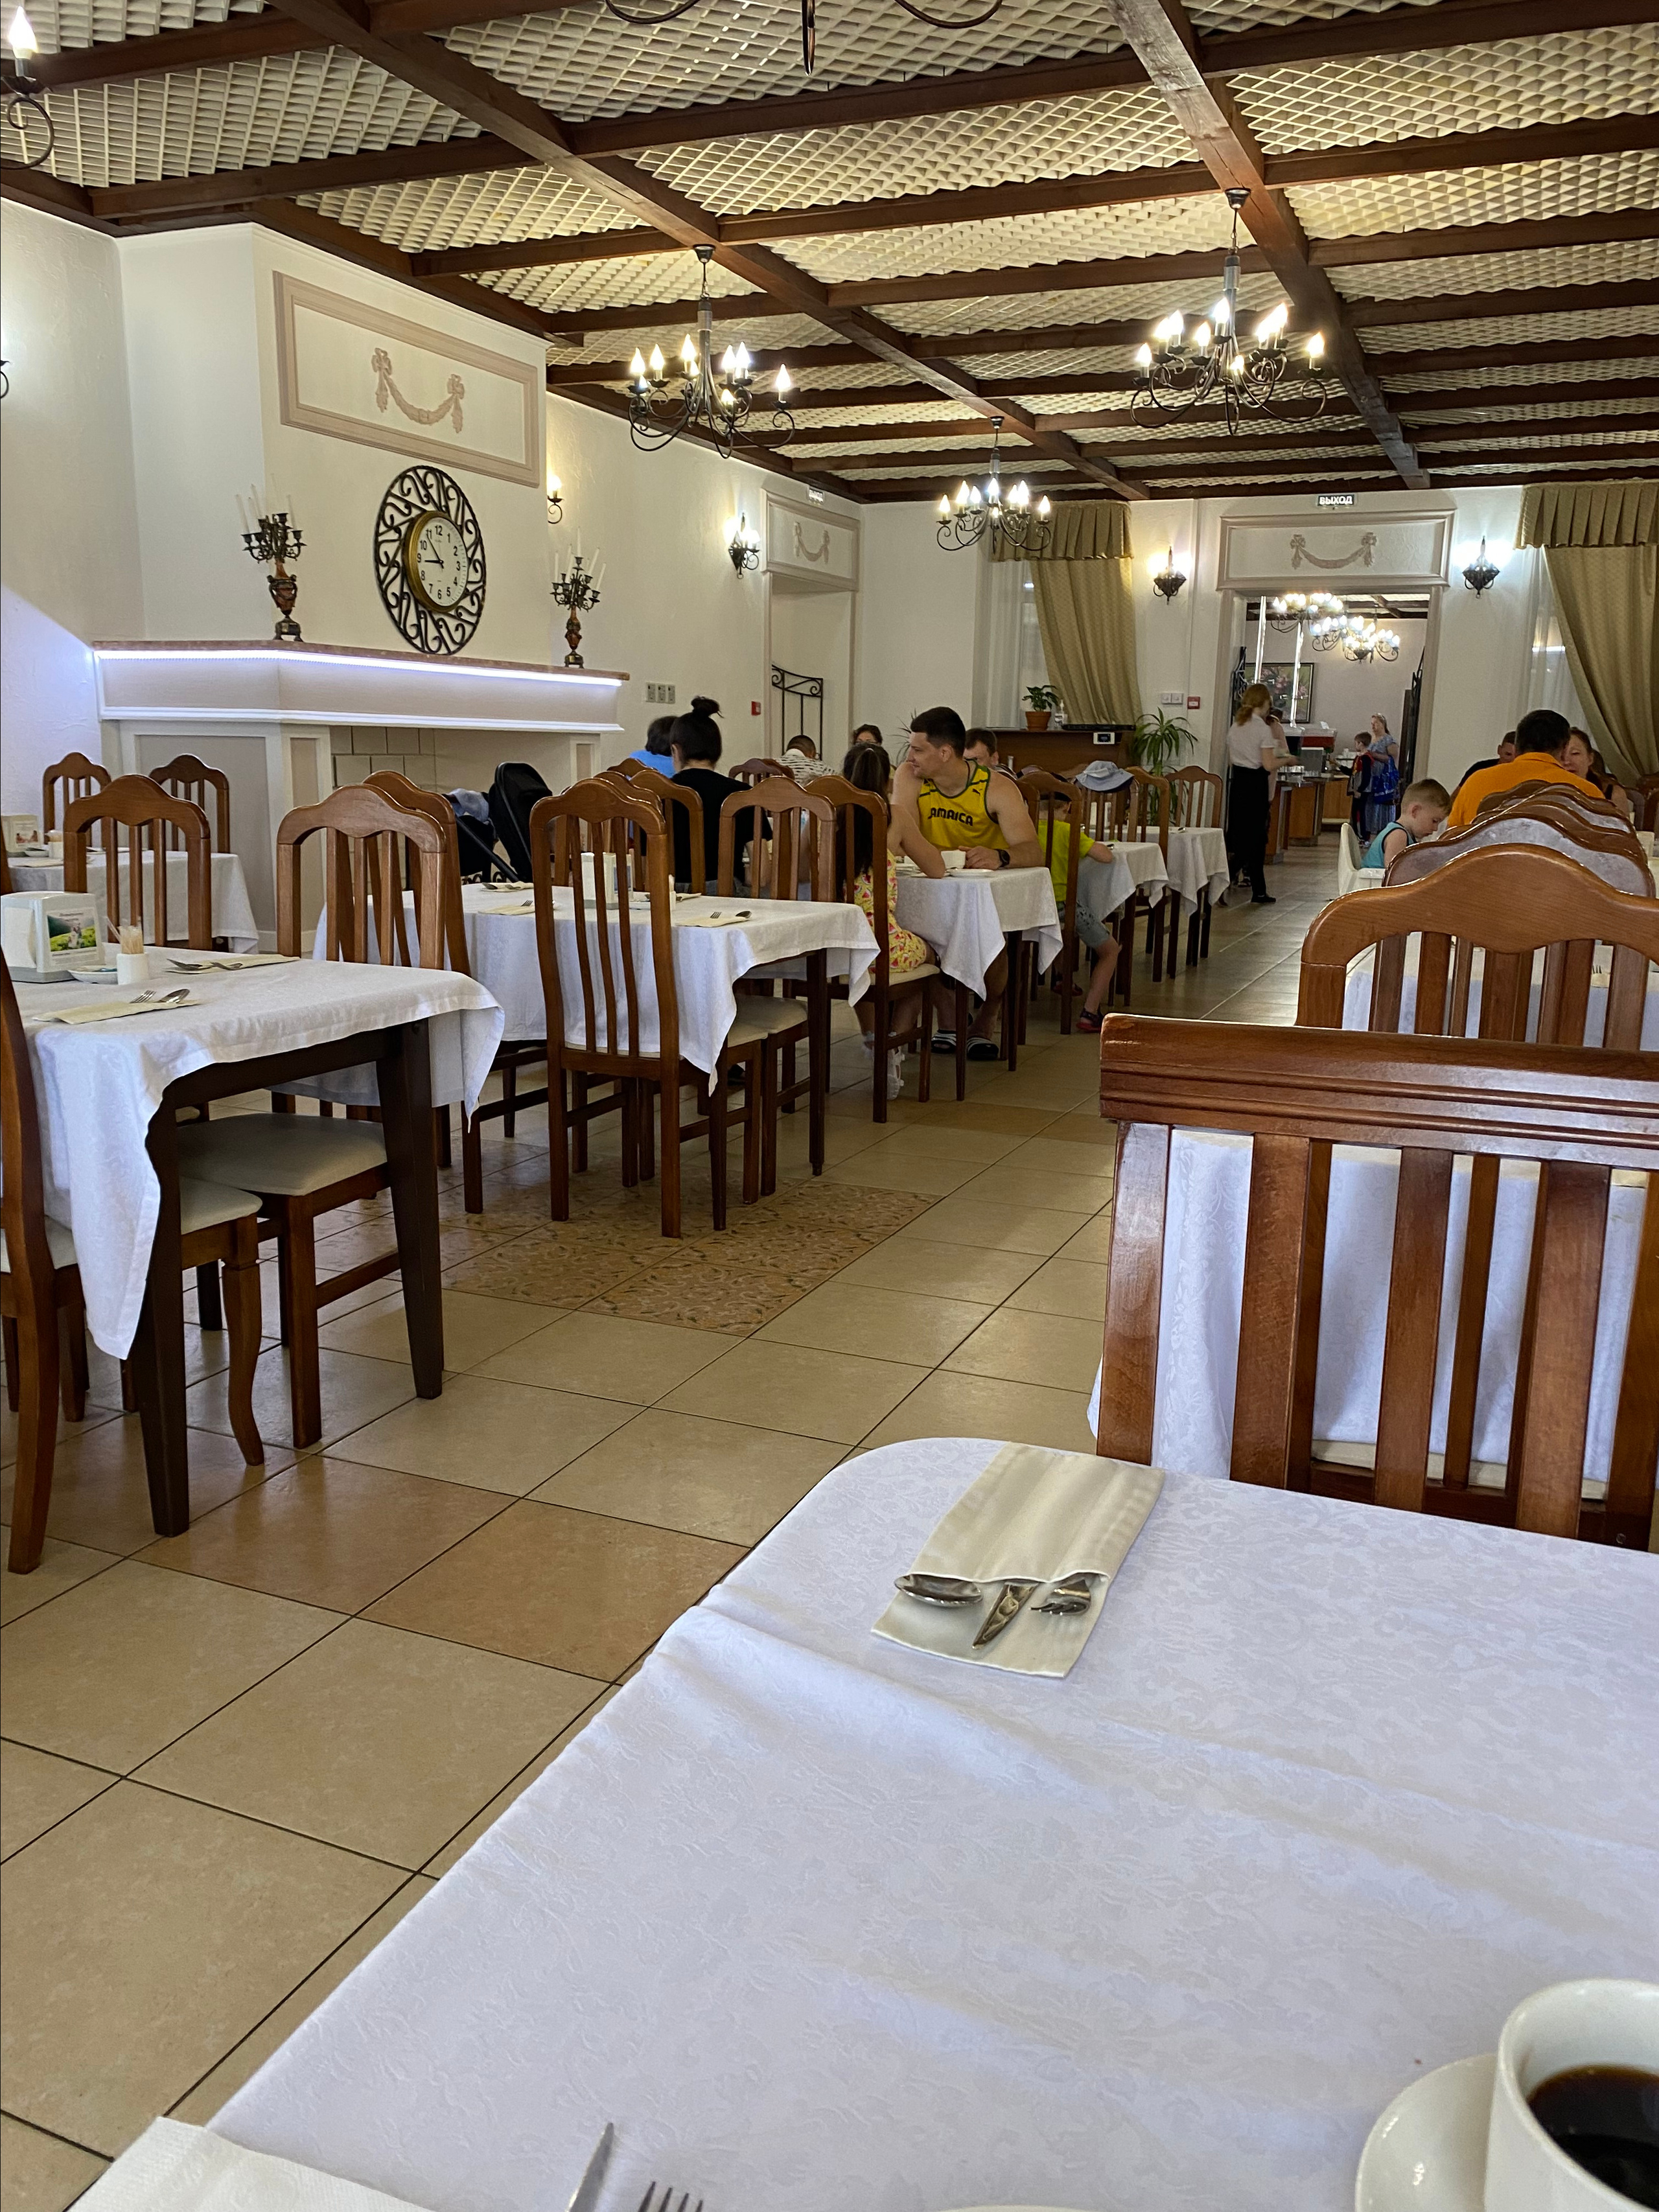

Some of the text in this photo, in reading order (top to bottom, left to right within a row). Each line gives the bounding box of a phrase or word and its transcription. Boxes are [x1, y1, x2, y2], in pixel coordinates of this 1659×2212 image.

[1319, 496, 1352, 505] ВЫХОД
[426, 528, 432, 539] 11
[435, 525, 443, 536] 12
[447, 533, 450, 543] 1
[420, 540, 427, 550] 10
[454, 546, 458, 556] 2
[417, 553, 421, 563] 9
[456, 561, 461, 571] 3
[421, 570, 425, 581] 8
[454, 576, 458, 586] 4
[429, 583, 433, 594] 7
[447, 587, 451, 597] 5
[437, 589, 442, 600] 6
